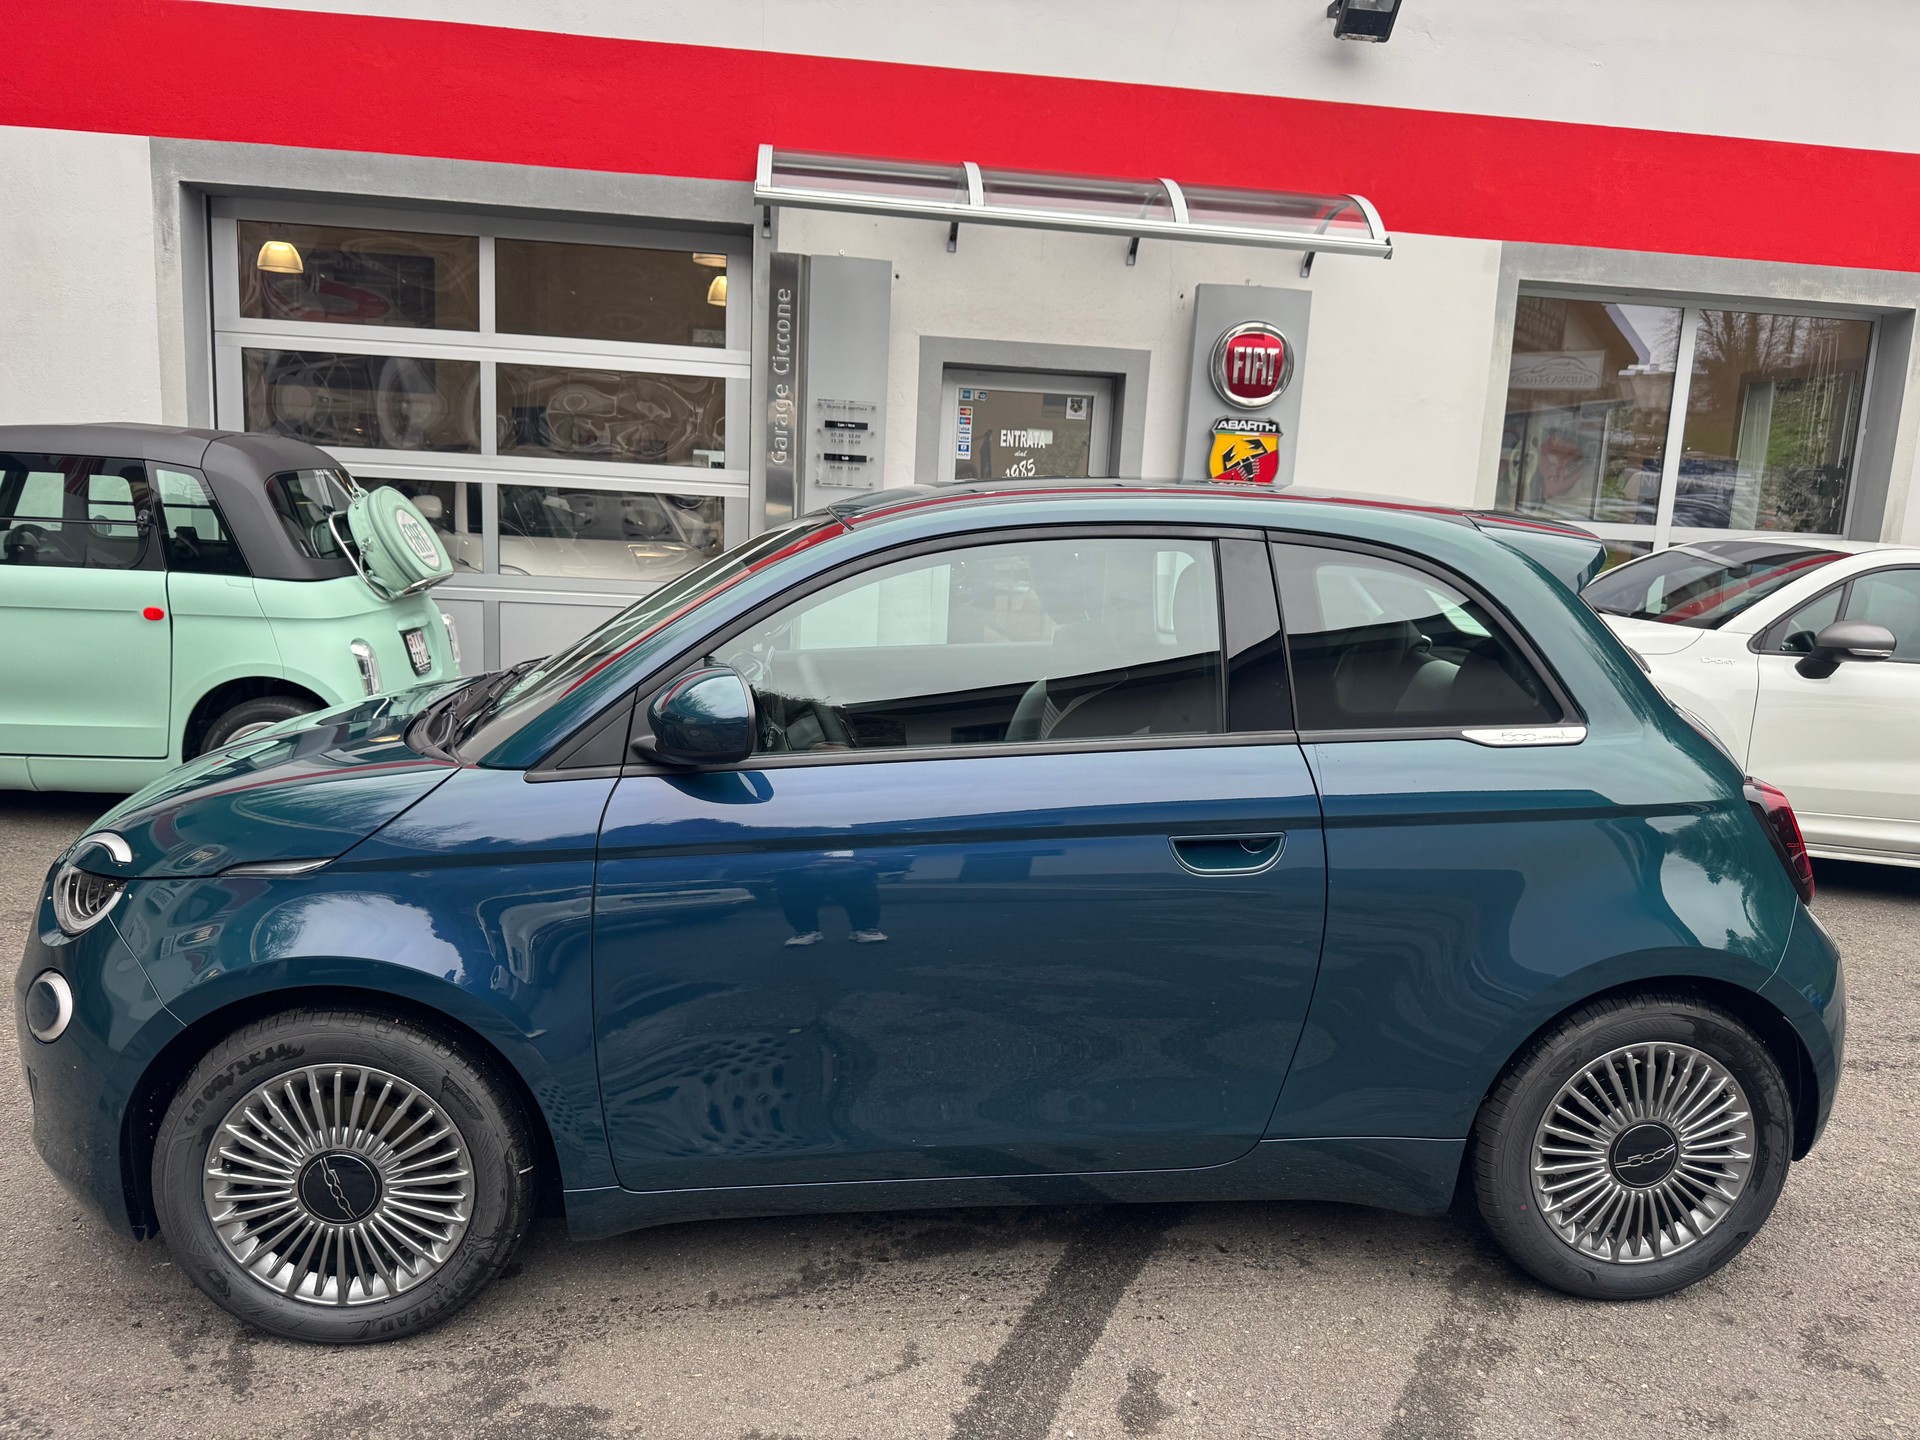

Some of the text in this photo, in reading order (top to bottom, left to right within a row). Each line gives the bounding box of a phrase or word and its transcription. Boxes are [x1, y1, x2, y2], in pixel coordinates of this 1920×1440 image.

[1232, 346, 1280, 386] FIAT
[772, 288, 794, 466] Garage Ciccone
[1217, 420, 1277, 432] ABARTH
[1000, 429, 1046, 449] ENTRATA
[1005, 458, 1036, 478] 1985
[1501, 731, 1538, 742] 500
[1625, 1147, 1667, 1169] 500
[322, 1166, 353, 1212] 500
